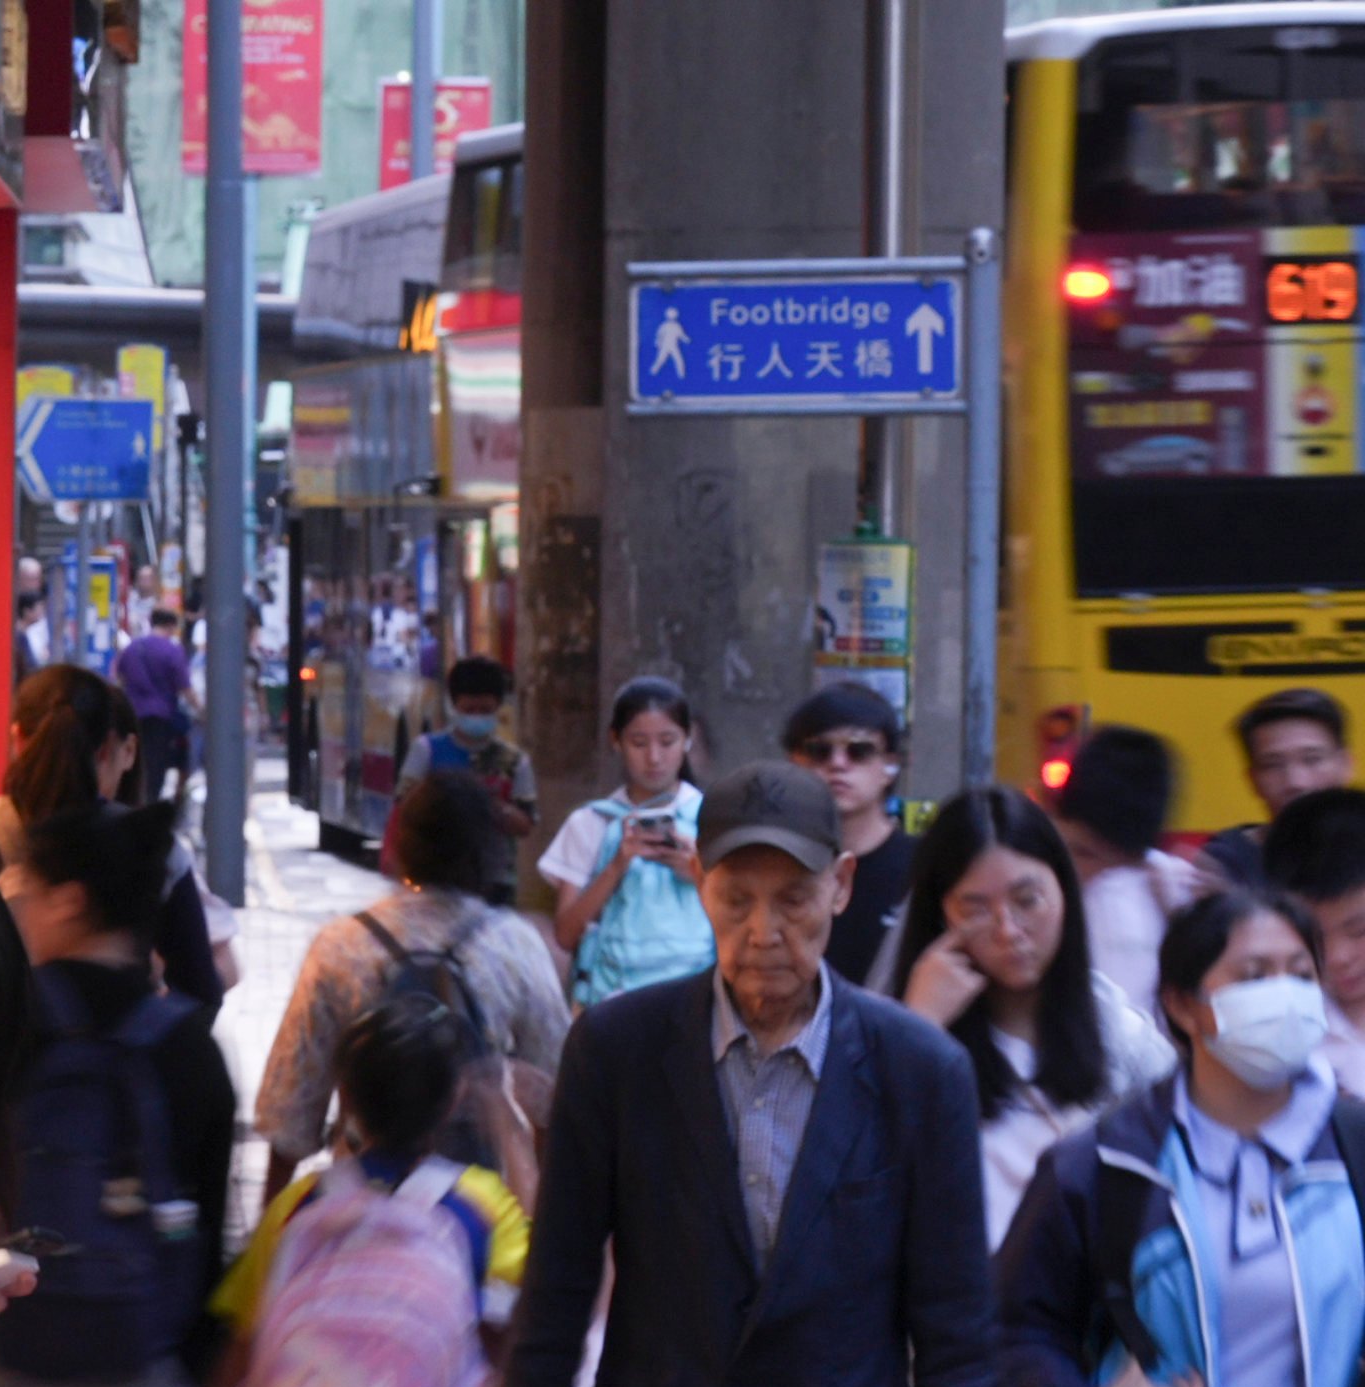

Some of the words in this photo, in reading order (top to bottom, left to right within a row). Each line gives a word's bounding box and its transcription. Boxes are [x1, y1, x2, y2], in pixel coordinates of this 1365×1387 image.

[710, 297, 891, 329] Footbridge
[708, 340, 892, 381] 行人天橋
